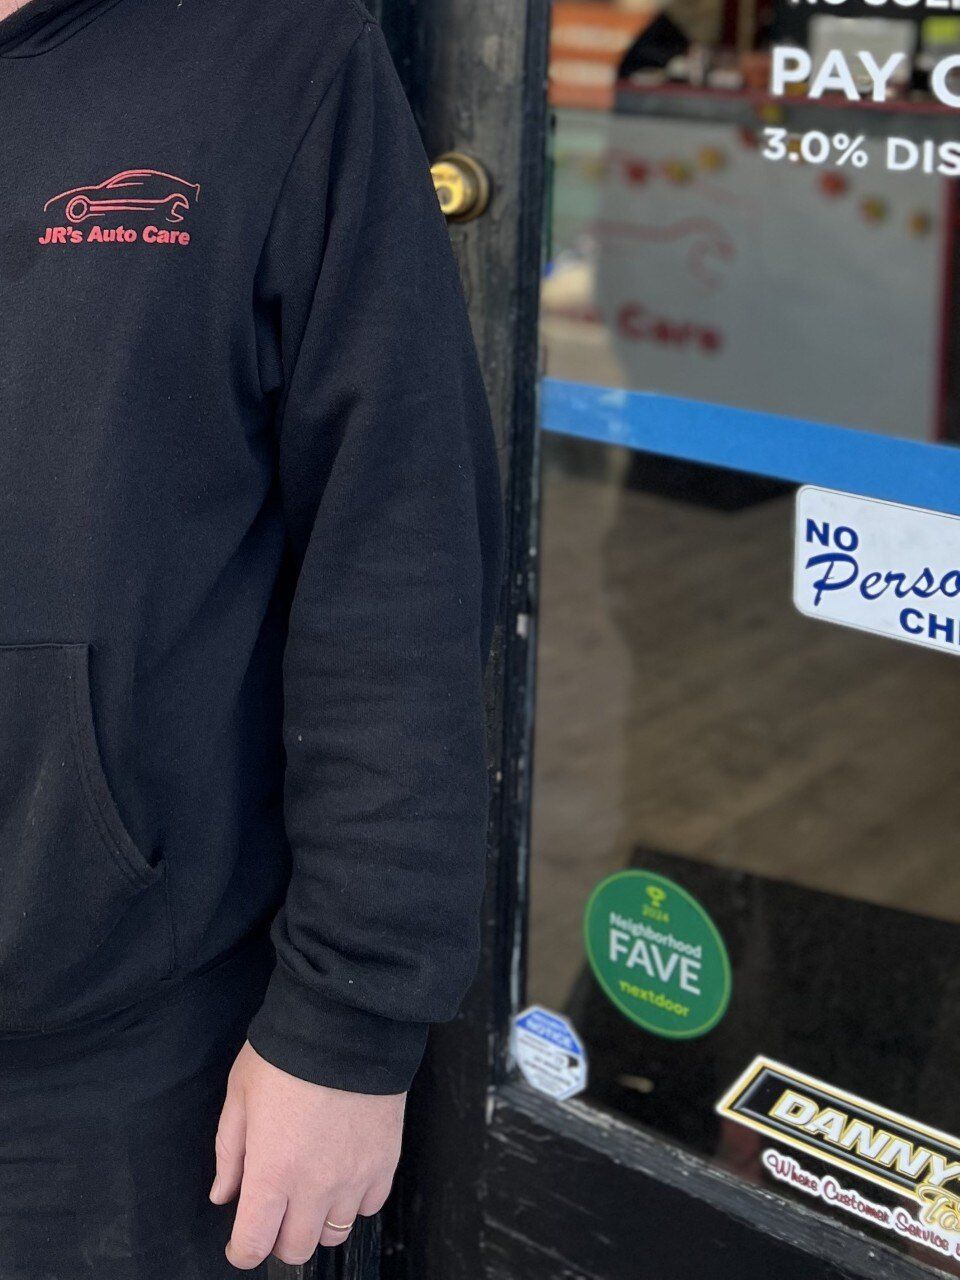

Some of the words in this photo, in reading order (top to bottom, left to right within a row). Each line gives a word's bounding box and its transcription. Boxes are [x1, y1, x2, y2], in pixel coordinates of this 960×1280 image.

[771, 46, 906, 102] PAY
[762, 127, 869, 168] 3.0%
[887, 136, 960, 176] DIS
[38, 226, 83, 245] JR's
[87, 225, 138, 243] Auto
[142, 225, 191, 245] Care
[806, 518, 859, 552] NO
[805, 552, 960, 606] Perso
[899, 607, 960, 646] CH
[609, 911, 702, 959] Neighborhood
[609, 928, 702, 996] FAVE
[619, 980, 690, 1017] nextdoor
[824, 1180, 891, 1224] Customer
[895, 1212, 949, 1251] Service
